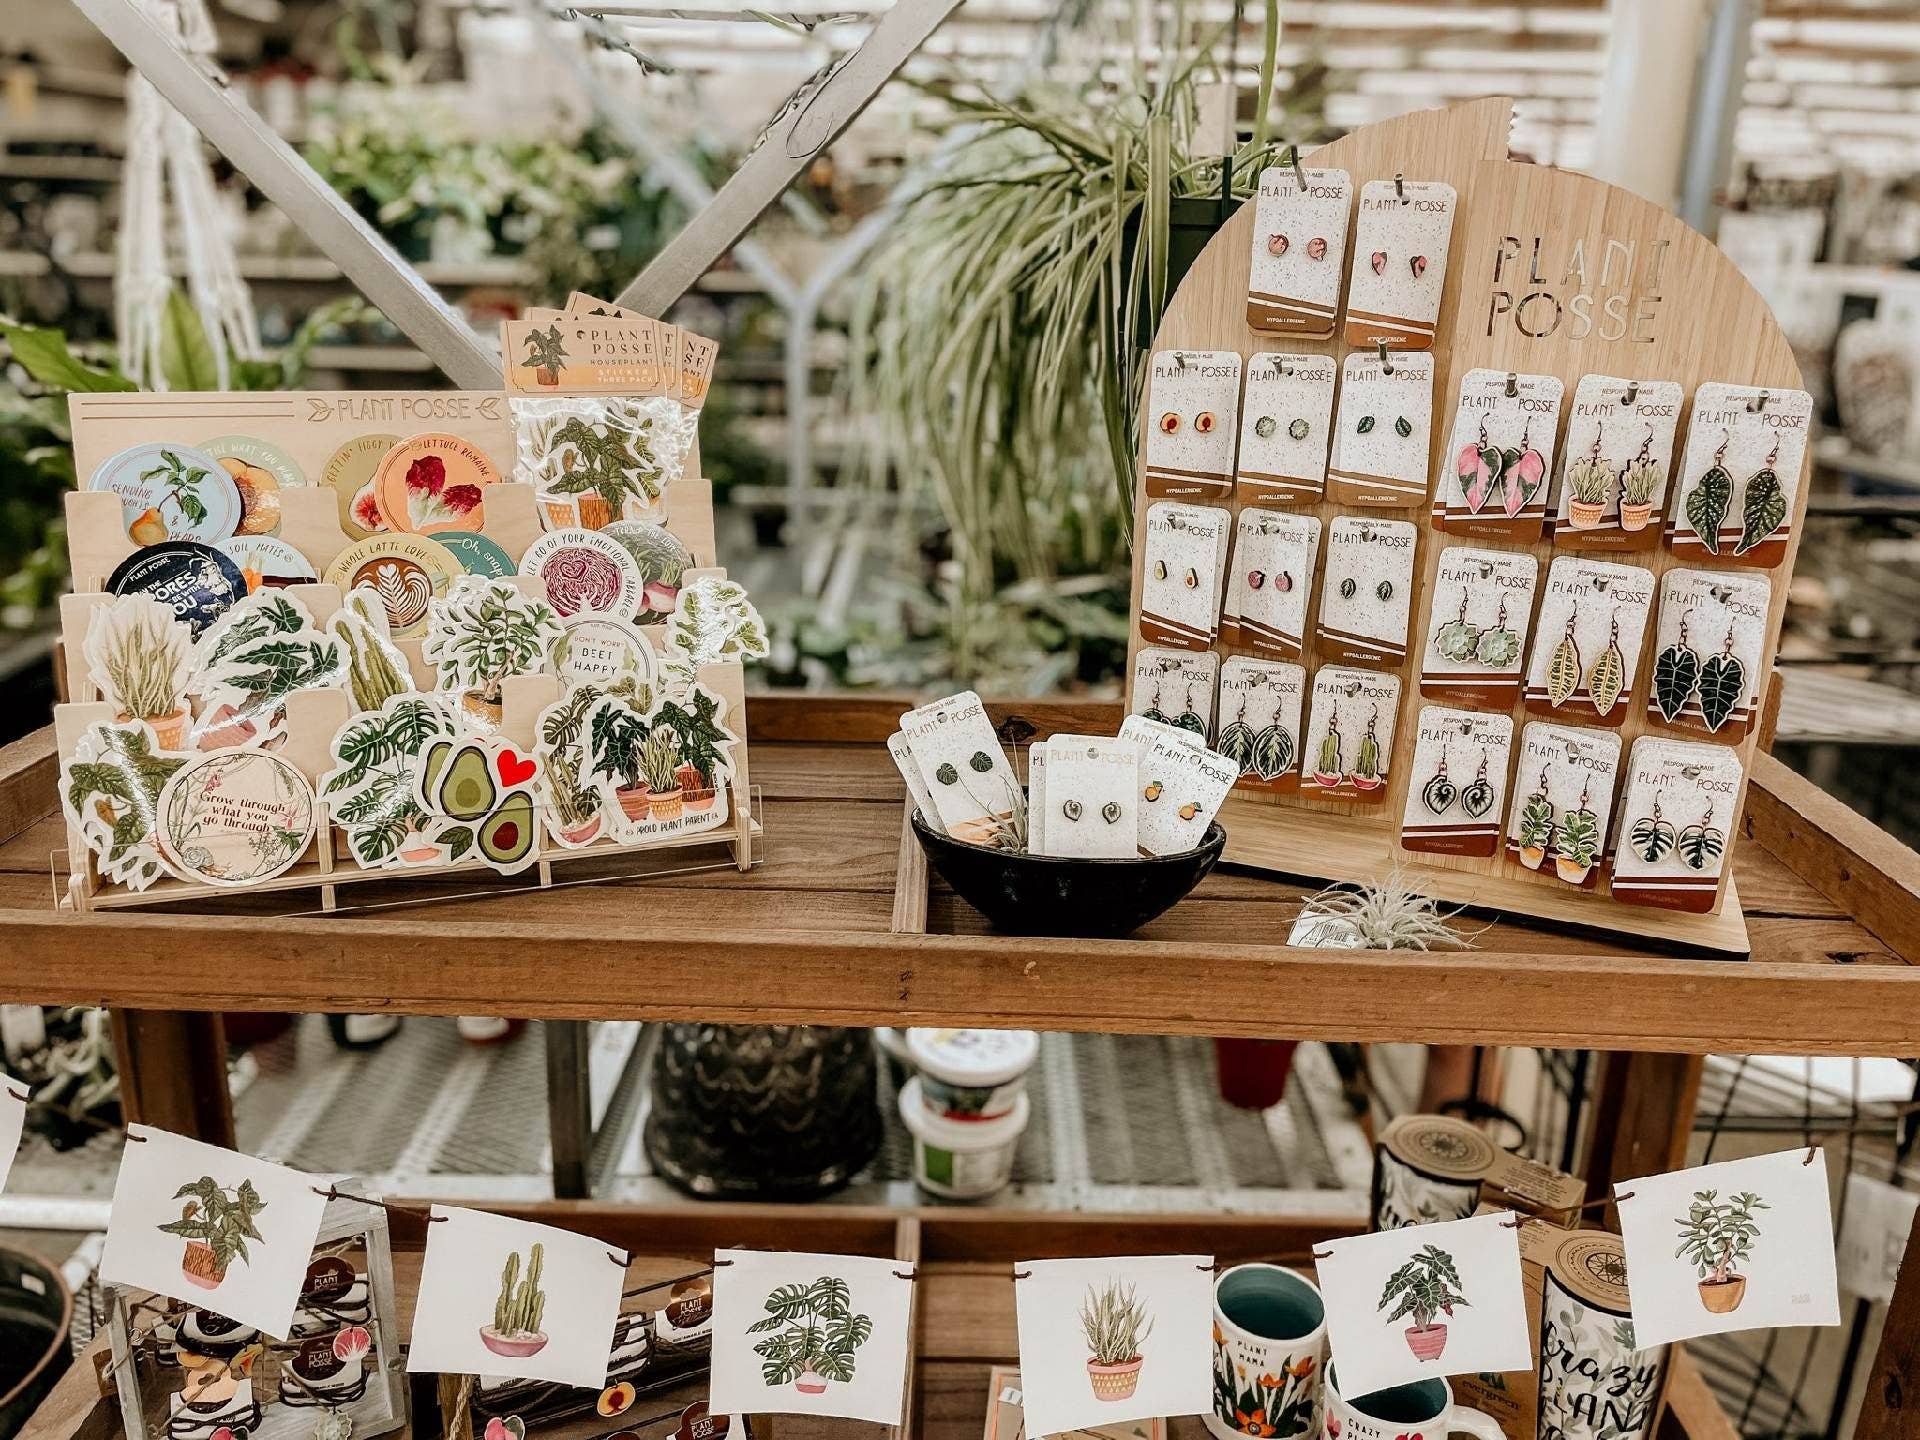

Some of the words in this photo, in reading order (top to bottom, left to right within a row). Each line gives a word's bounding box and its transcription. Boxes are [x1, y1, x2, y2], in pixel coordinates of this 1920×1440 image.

[1261, 186, 1294, 197] PLANT
[1310, 187, 1343, 199] POSSE
[1363, 199, 1397, 211] PLANT
[1415, 200, 1447, 212] POSSE
[1493, 236, 1670, 288] PLANT
[1487, 291, 1662, 343] POSSE
[591, 330, 652, 341] PLANT
[593, 343, 653, 354] POSSE
[1201, 366, 1231, 378] POSSE
[1347, 370, 1377, 382] PLANT
[1395, 370, 1428, 381] POSSE
[337, 398, 394, 421] PLANT
[402, 398, 471, 420] POSSE
[1462, 396, 1498, 410] PLANT
[1518, 399, 1554, 413] POSSE
[1577, 404, 1615, 416] PLANT
[1636, 404, 1674, 417] POSSE
[1699, 411, 1738, 425] PLANT
[1762, 413, 1805, 428] POSSE
[423, 439, 458, 450] LETTUCE
[461, 448, 489, 476] ROMAINE
[112, 483, 152, 499] SENDING
[170, 515, 178, 526] &
[1188, 525, 1215, 538] POSSE
[1280, 531, 1304, 544] POSSE
[1379, 536, 1411, 548] POSSE
[229, 543, 248, 554] SOIL
[256, 543, 284, 558] MATES
[339, 549, 366, 573] WHOLE
[405, 544, 428, 559] LOVE
[527, 560, 537, 576] LET
[536, 547, 546, 559] GO
[549, 538, 557, 549] OF
[561, 533, 585, 544] YOUR
[590, 537, 631, 571] EMOTIONAL
[129, 568, 147, 582] PLANT
[149, 557, 170, 573] POSSE
[147, 580, 162, 591] THE
[151, 571, 197, 600] ORES
[1441, 569, 1476, 583] PLANT
[1495, 575, 1532, 589] POSSE
[1552, 581, 1589, 597] PLANT
[1610, 589, 1648, 605] POSSE
[173, 594, 198, 615] OU
[1670, 590, 1704, 607] PLANT
[1725, 600, 1761, 617] POSSE
[582, 648, 612, 660] BEET
[1343, 651, 1382, 661] HYPOALLERGENIC
[574, 661, 617, 675] HAPPY
[1182, 670, 1211, 682] POSSE
[1268, 682, 1298, 693] POSSE
[1363, 687, 1394, 698] POSSE
[907, 720, 938, 740] PLANT
[951, 705, 983, 727] POSSE
[1421, 729, 1455, 742] PLANT
[1473, 734, 1507, 746] POSSE
[894, 745, 912, 759] PLA
[1528, 742, 1560, 760] PLANT
[1578, 757, 1613, 774] POSSE
[1153, 744, 1186, 764] PLANT
[1199, 762, 1232, 785] POSSE
[1638, 772, 1676, 787] PLANT
[1696, 778, 1735, 794] POSSE
[200, 791, 234, 806] Grow
[240, 799, 285, 814] through
[212, 805, 241, 818] what
[247, 811, 268, 822] you
[202, 815, 218, 826] go
[224, 817, 270, 833] through
[661, 819, 683, 832] PLANT
[685, 813, 710, 826] PARENT
[680, 1298, 702, 1311] PLANT
[308, 1351, 332, 1362] PLANT
[1238, 1341, 1267, 1356] PLANT
[1240, 1354, 1264, 1366] MAMA
[1349, 1418, 1380, 1438] CRAZY
